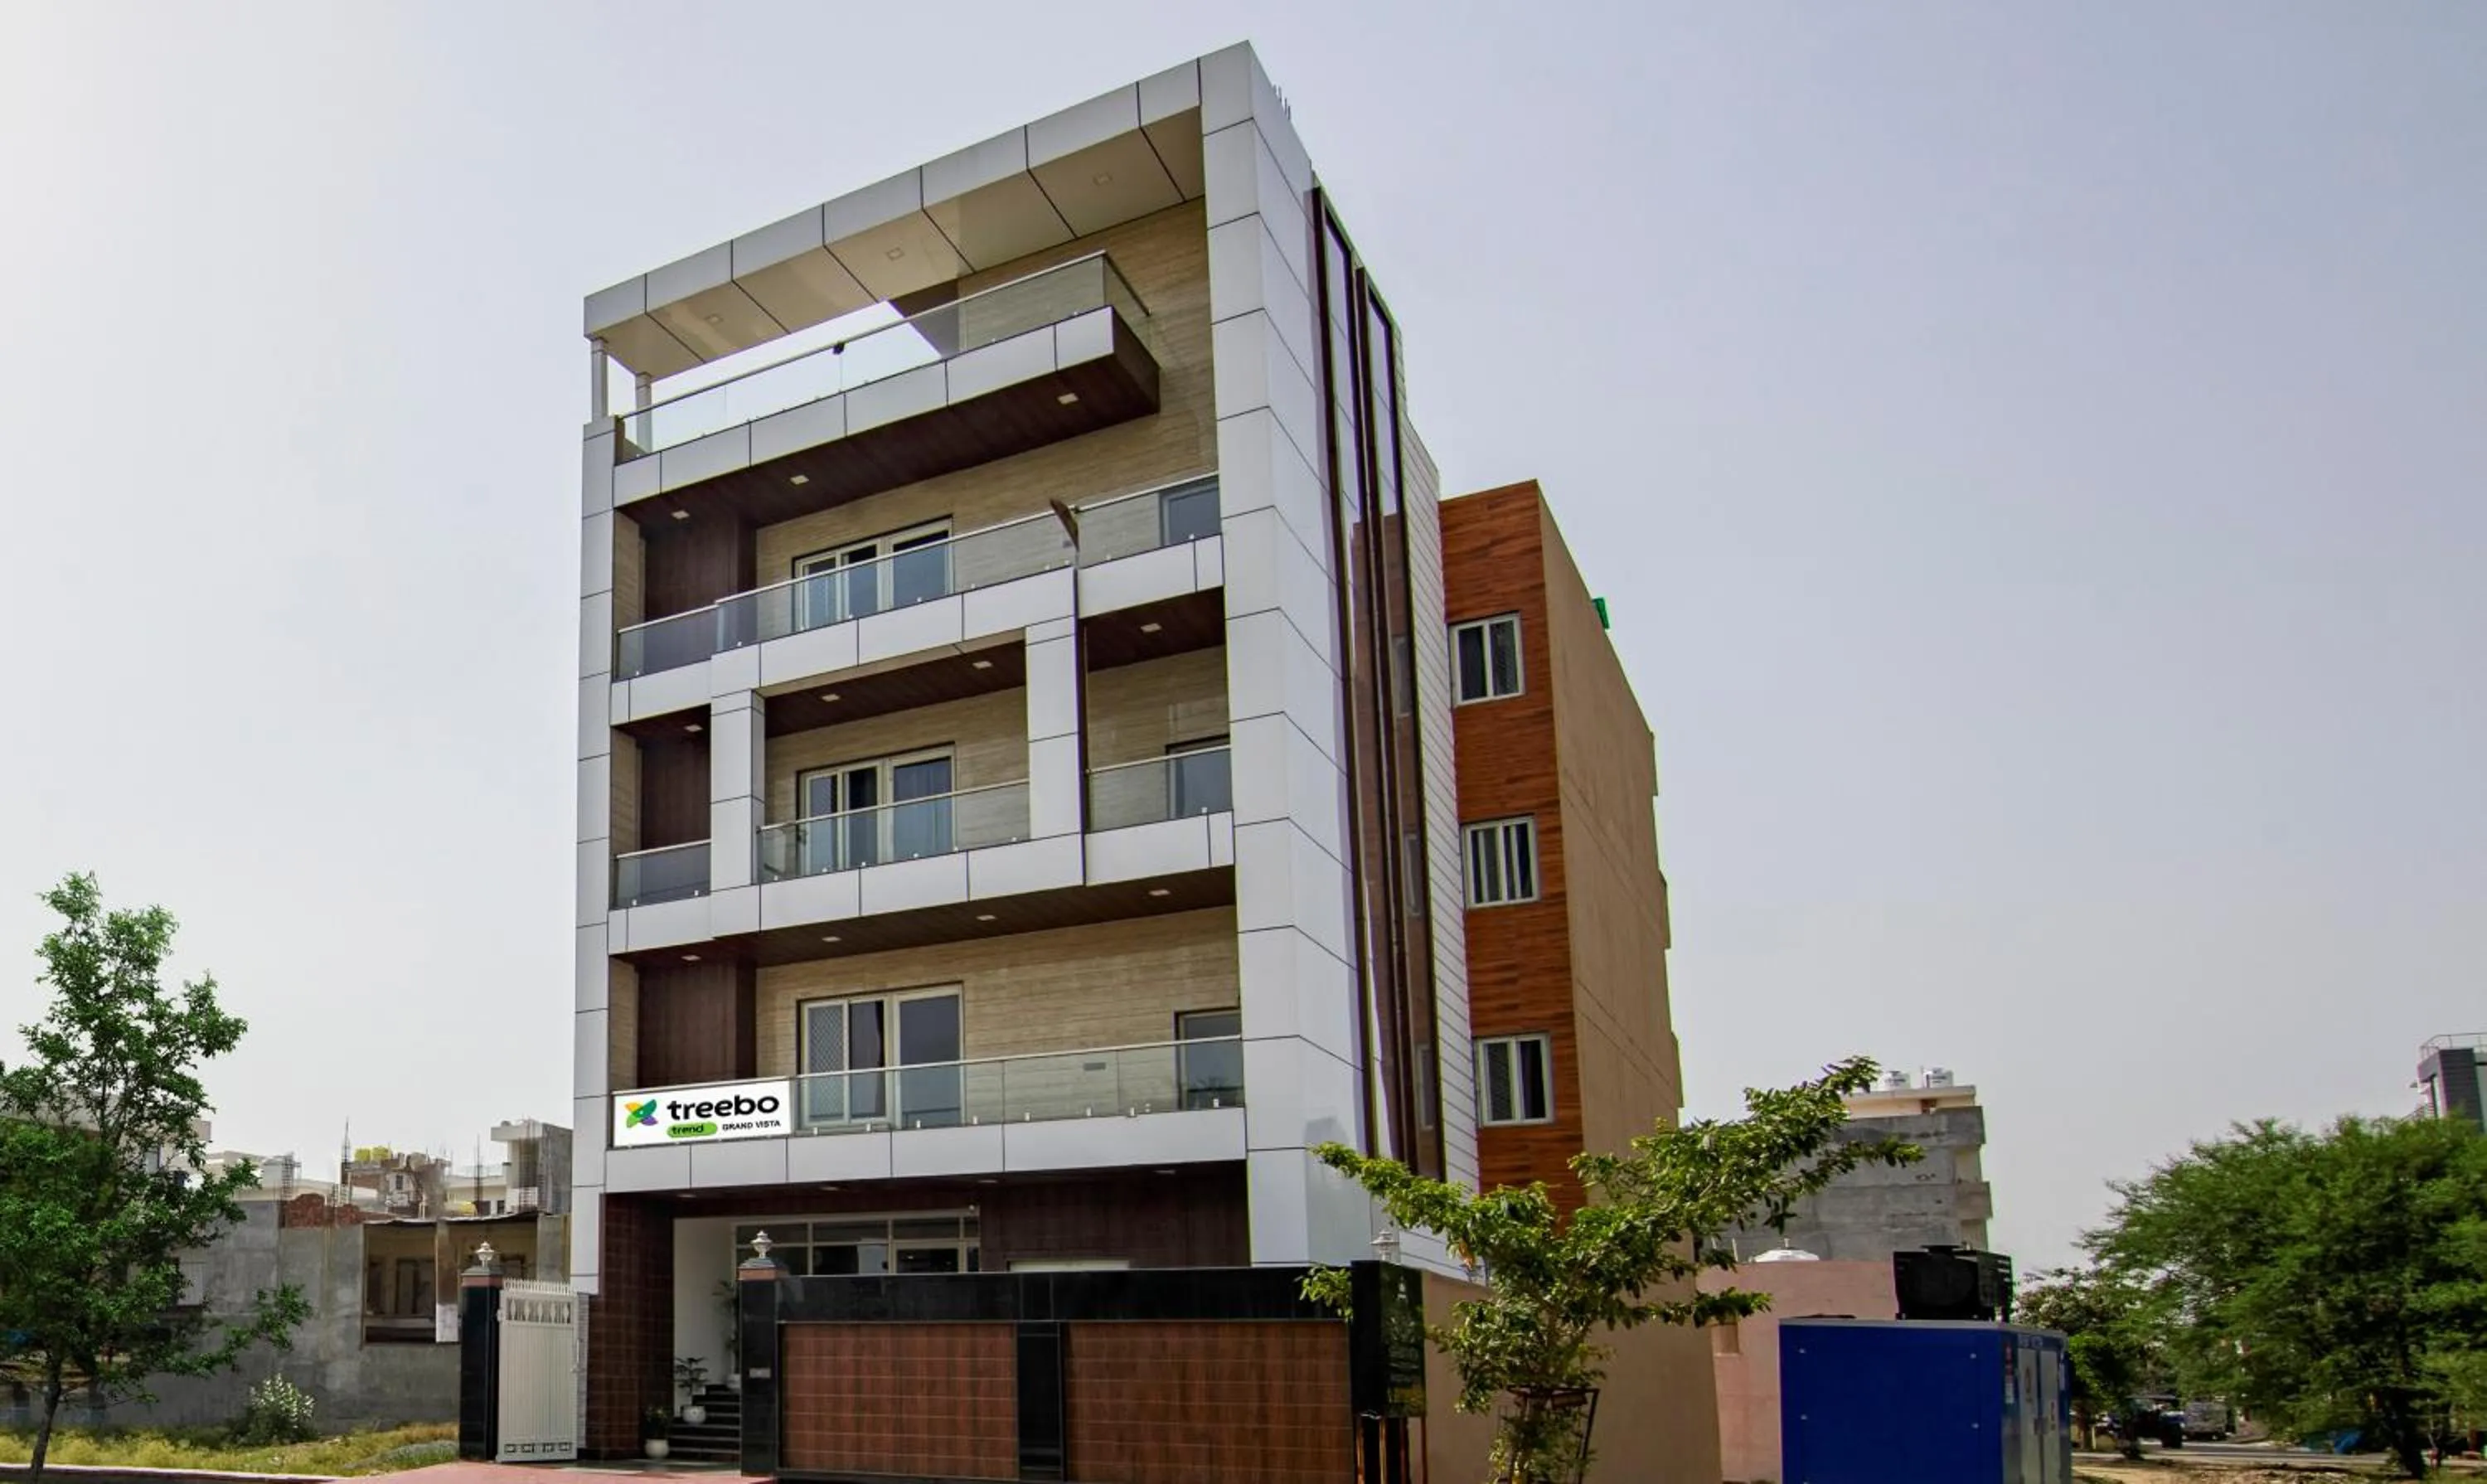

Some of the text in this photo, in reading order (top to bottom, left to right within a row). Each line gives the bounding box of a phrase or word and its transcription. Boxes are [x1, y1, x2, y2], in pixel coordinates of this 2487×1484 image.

[667, 1094, 779, 1120] treebo
[671, 1124, 705, 1134] trend
[722, 1120, 781, 1132] GRAND VISTA
